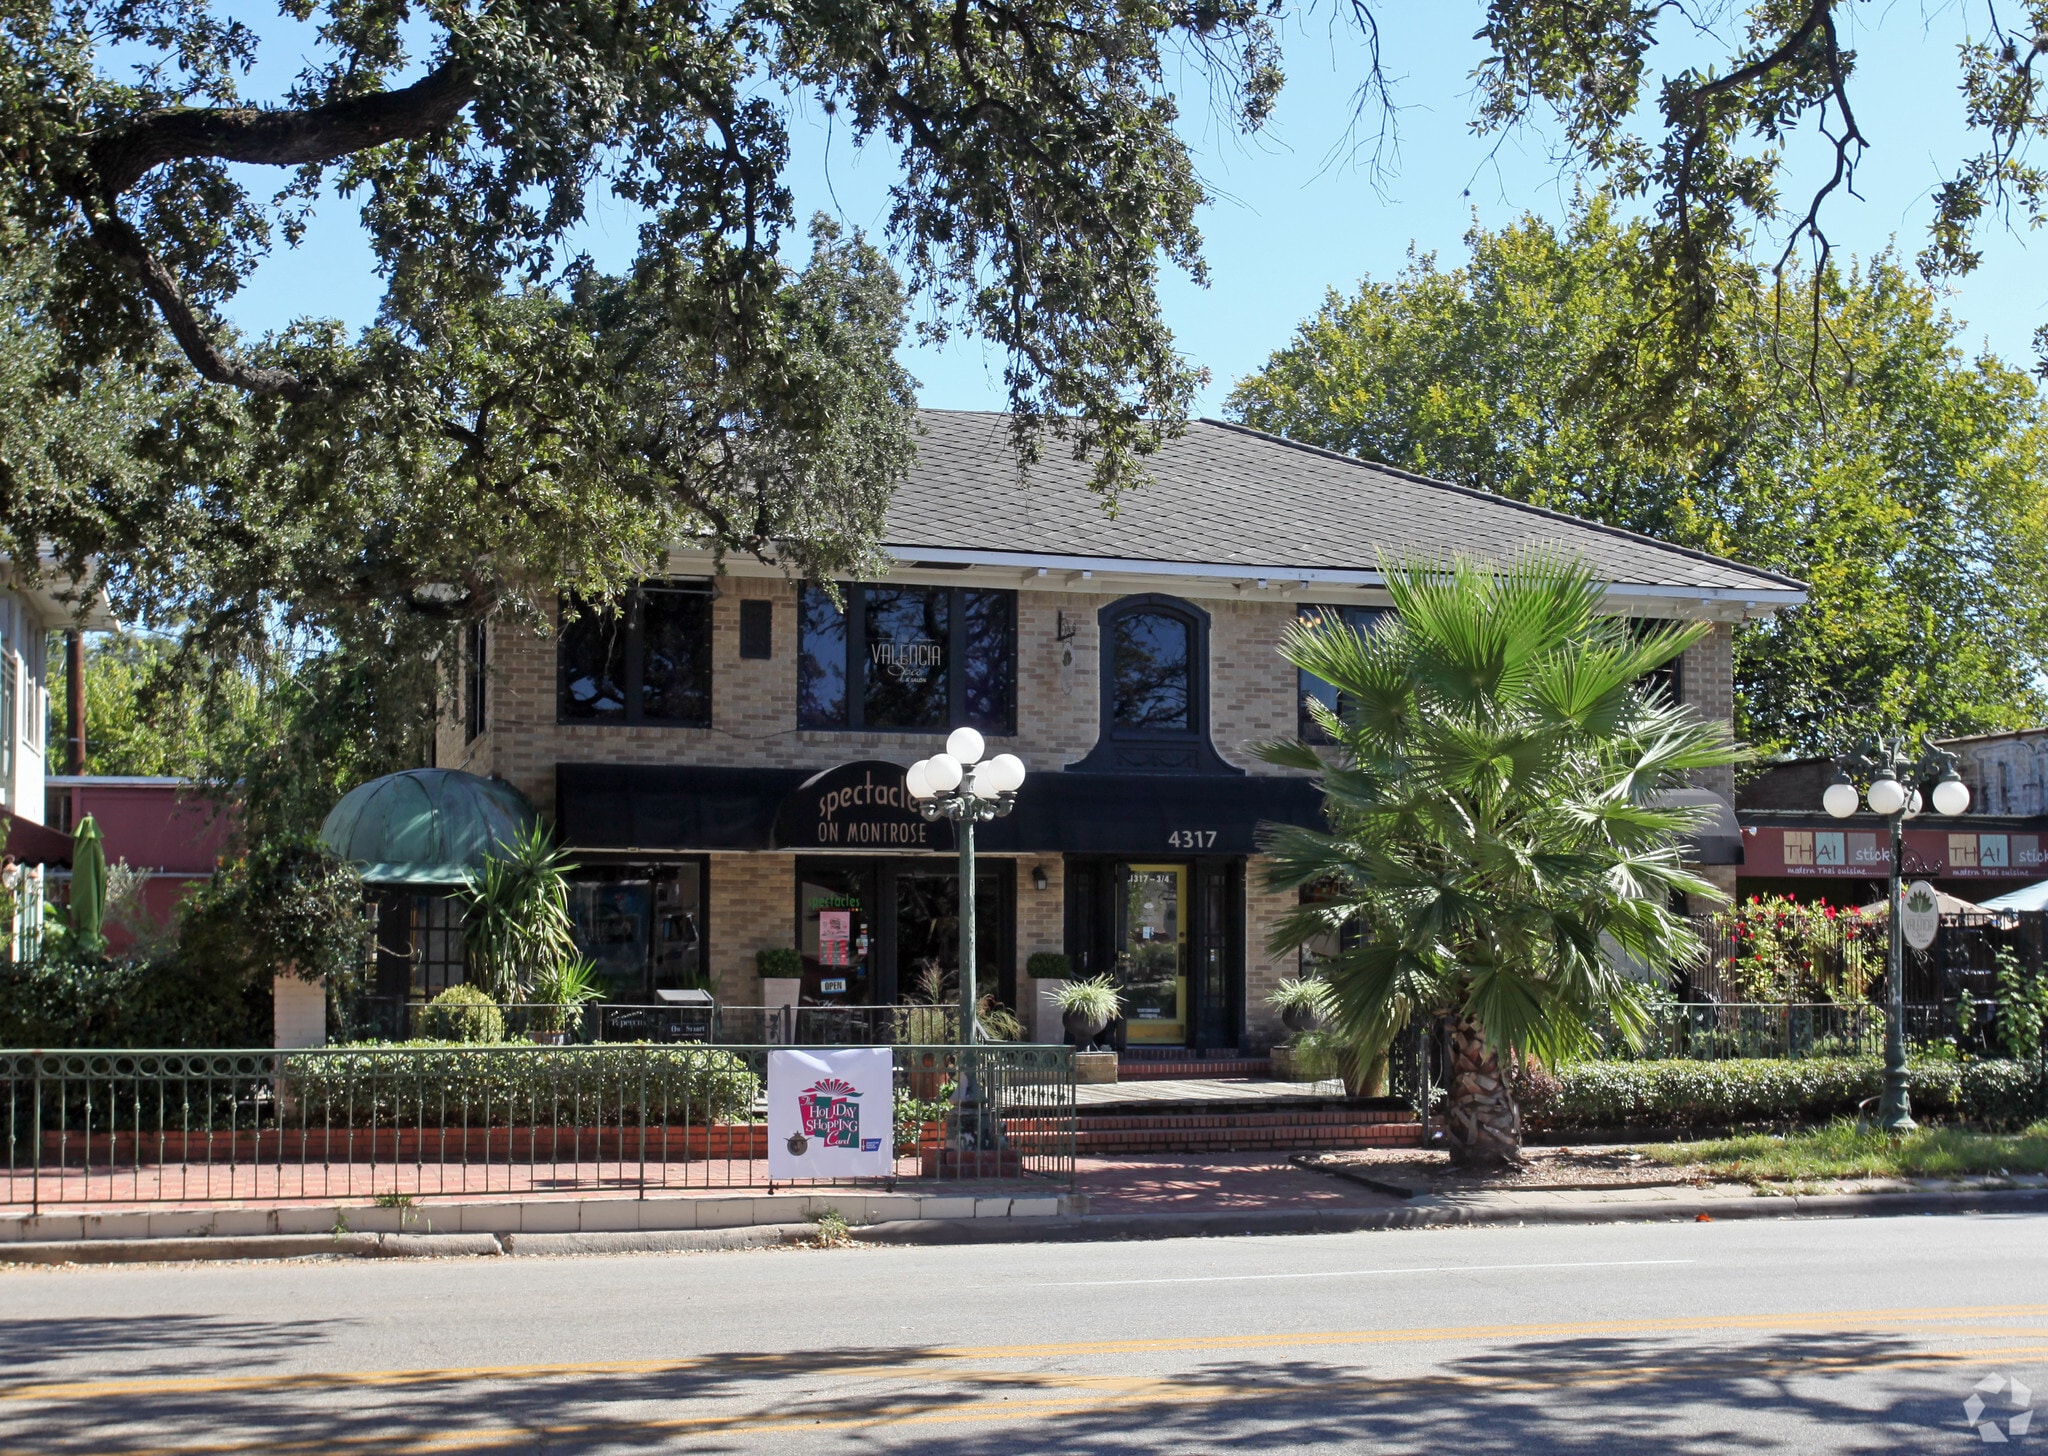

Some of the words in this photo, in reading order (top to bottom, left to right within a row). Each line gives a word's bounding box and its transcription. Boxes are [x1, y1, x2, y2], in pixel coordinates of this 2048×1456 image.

[871, 644, 941, 665] VALENCIA
[820, 770, 925, 820] spectacle
[818, 822, 838, 842] ON
[847, 822, 926, 843] MONTROSE
[1168, 830, 1217, 848] 4317
[1785, 844, 1837, 861] THAI
[1950, 846, 2001, 863] THAI
[1787, 866, 1815, 875] modern
[1818, 867, 1835, 875] Thai
[1982, 868, 2000, 876] Thai
[808, 893, 861, 908] spectacles
[824, 982, 843, 990] OPEN
[800, 1095, 815, 1106] The
[809, 1103, 857, 1119] HOLIDAY
[806, 1118, 858, 1133] SHOPPING
[827, 1130, 852, 1145] Card
